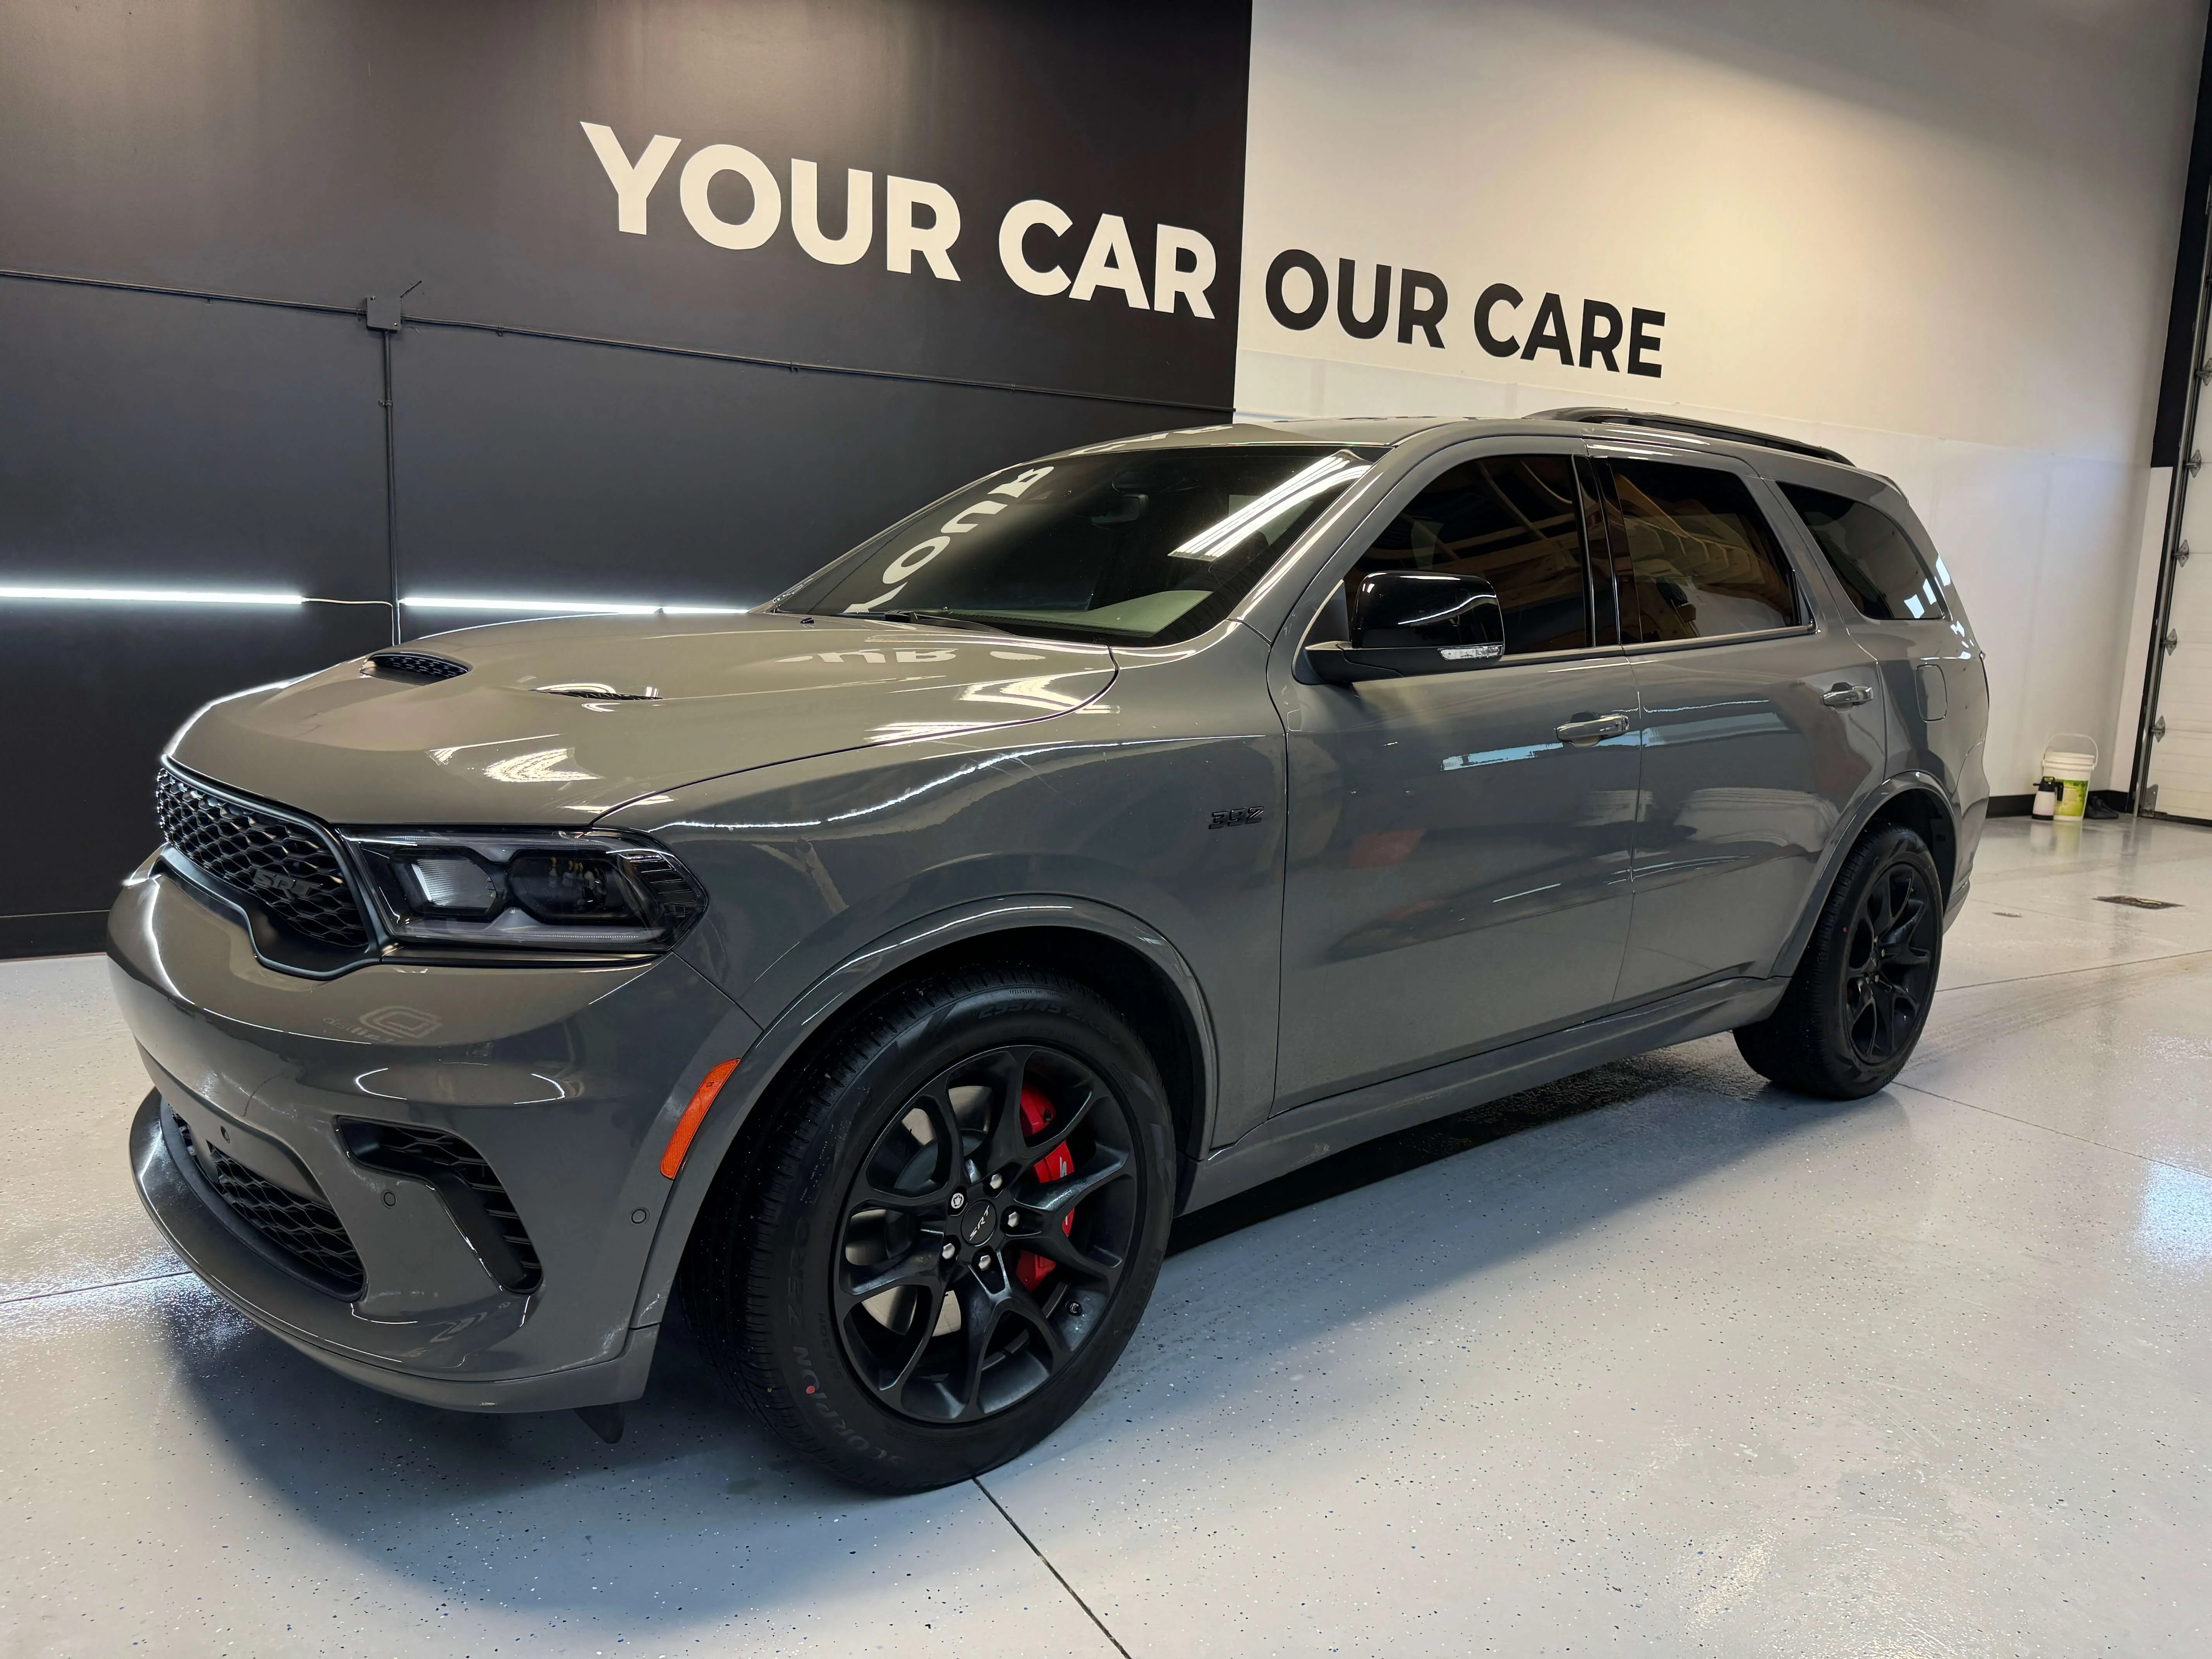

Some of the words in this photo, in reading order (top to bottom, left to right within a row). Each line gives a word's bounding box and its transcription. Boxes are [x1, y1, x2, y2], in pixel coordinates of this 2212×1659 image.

[580, 121, 960, 281] YOUR
[999, 200, 1216, 319] CAR
[1266, 249, 1448, 349] OUR
[1474, 283, 1665, 378] CARE
[1208, 806, 1264, 830] 392
[252, 869, 323, 900] SRT
[793, 1346, 905, 1465] SCORPION
